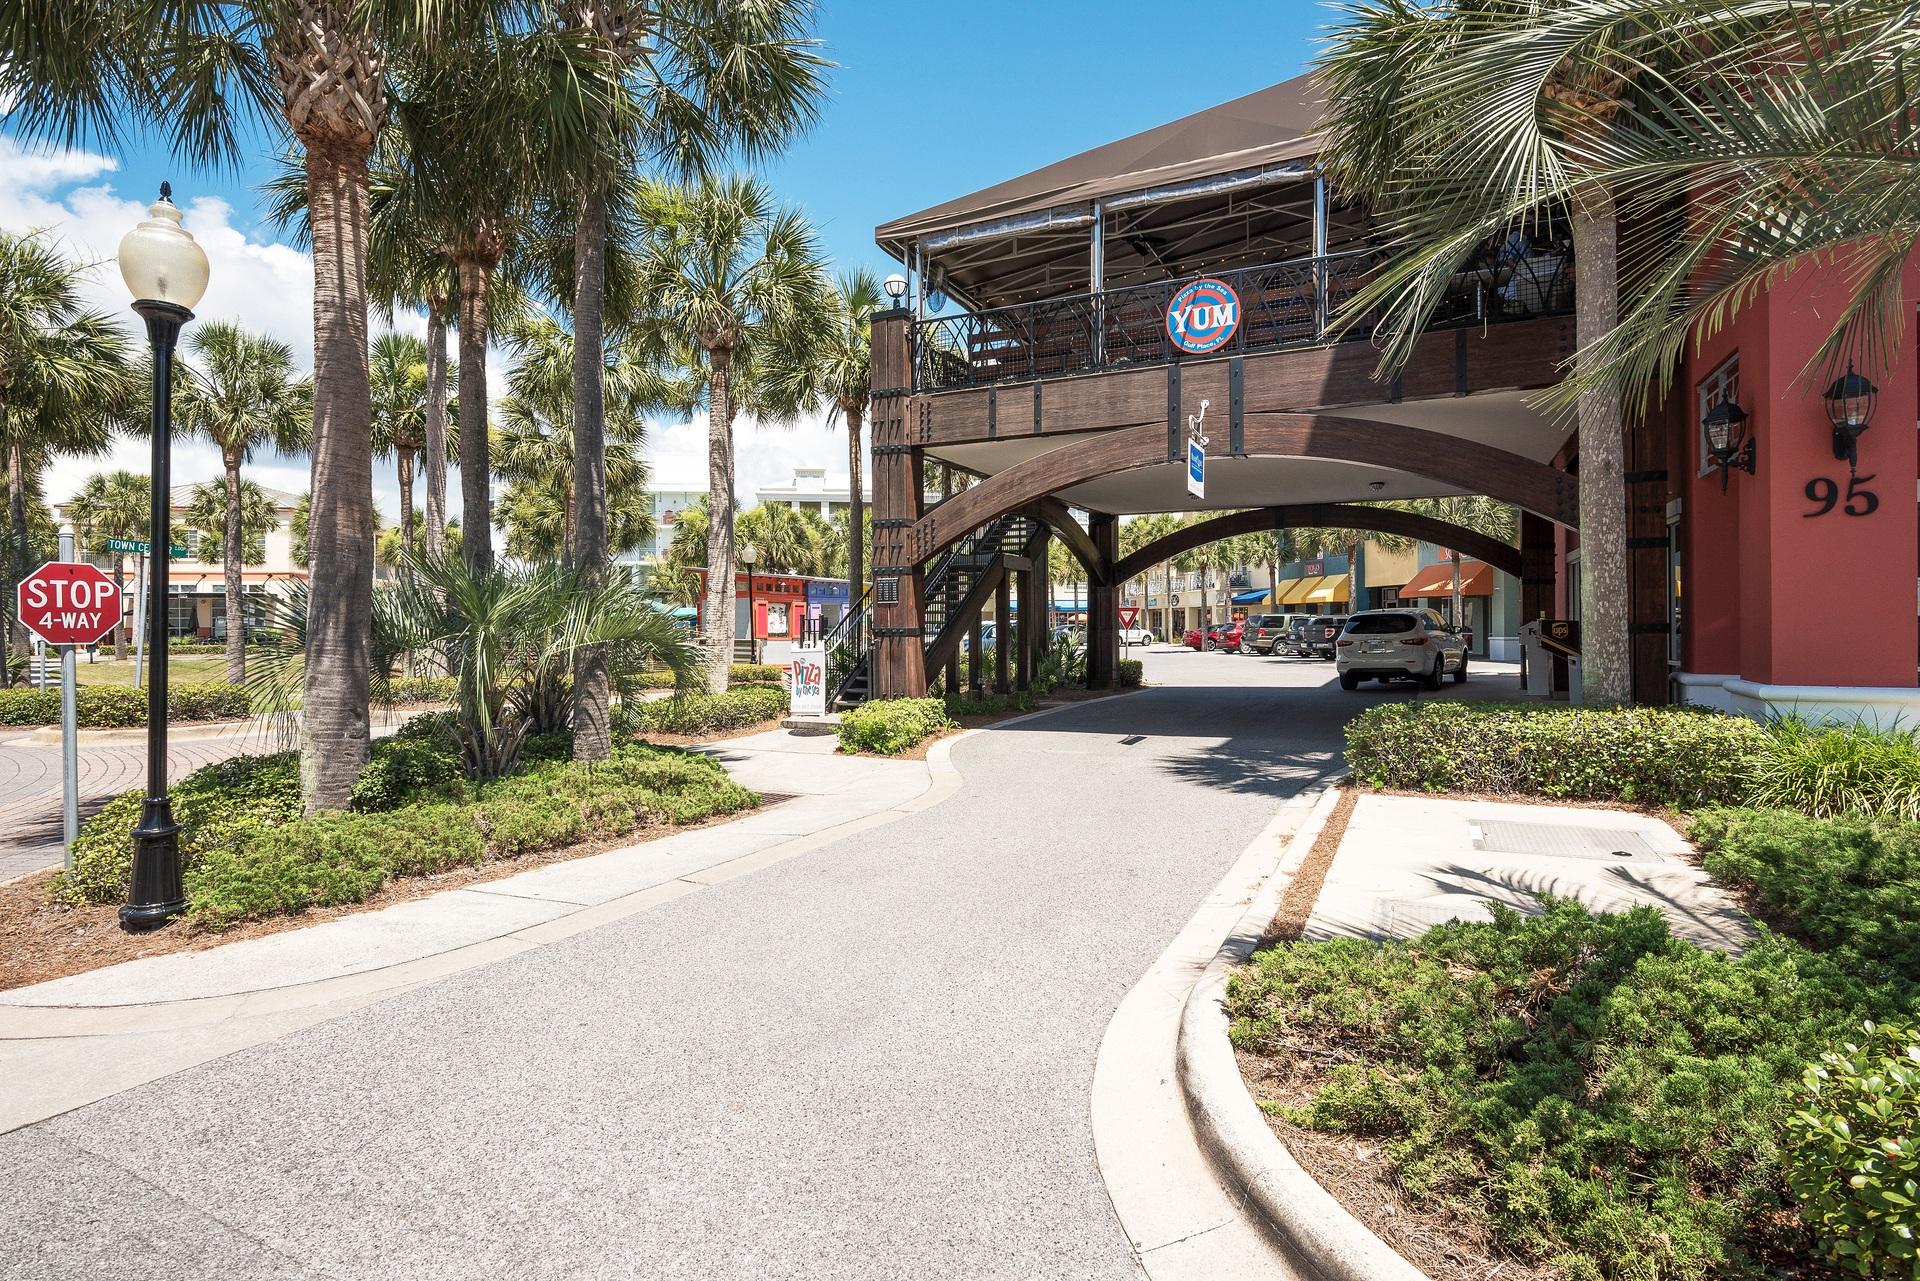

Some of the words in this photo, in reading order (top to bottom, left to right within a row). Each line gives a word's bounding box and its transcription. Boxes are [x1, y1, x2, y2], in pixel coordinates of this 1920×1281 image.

[1170, 302, 1236, 332] YUM
[1803, 474, 1879, 518] 95
[109, 539, 135, 551] TOWN
[27, 579, 114, 609] STOP
[39, 612, 102, 629] 4-WAY
[1554, 627, 1567, 636] ups
[793, 658, 821, 685] Pizza
[796, 686, 802, 698] by
